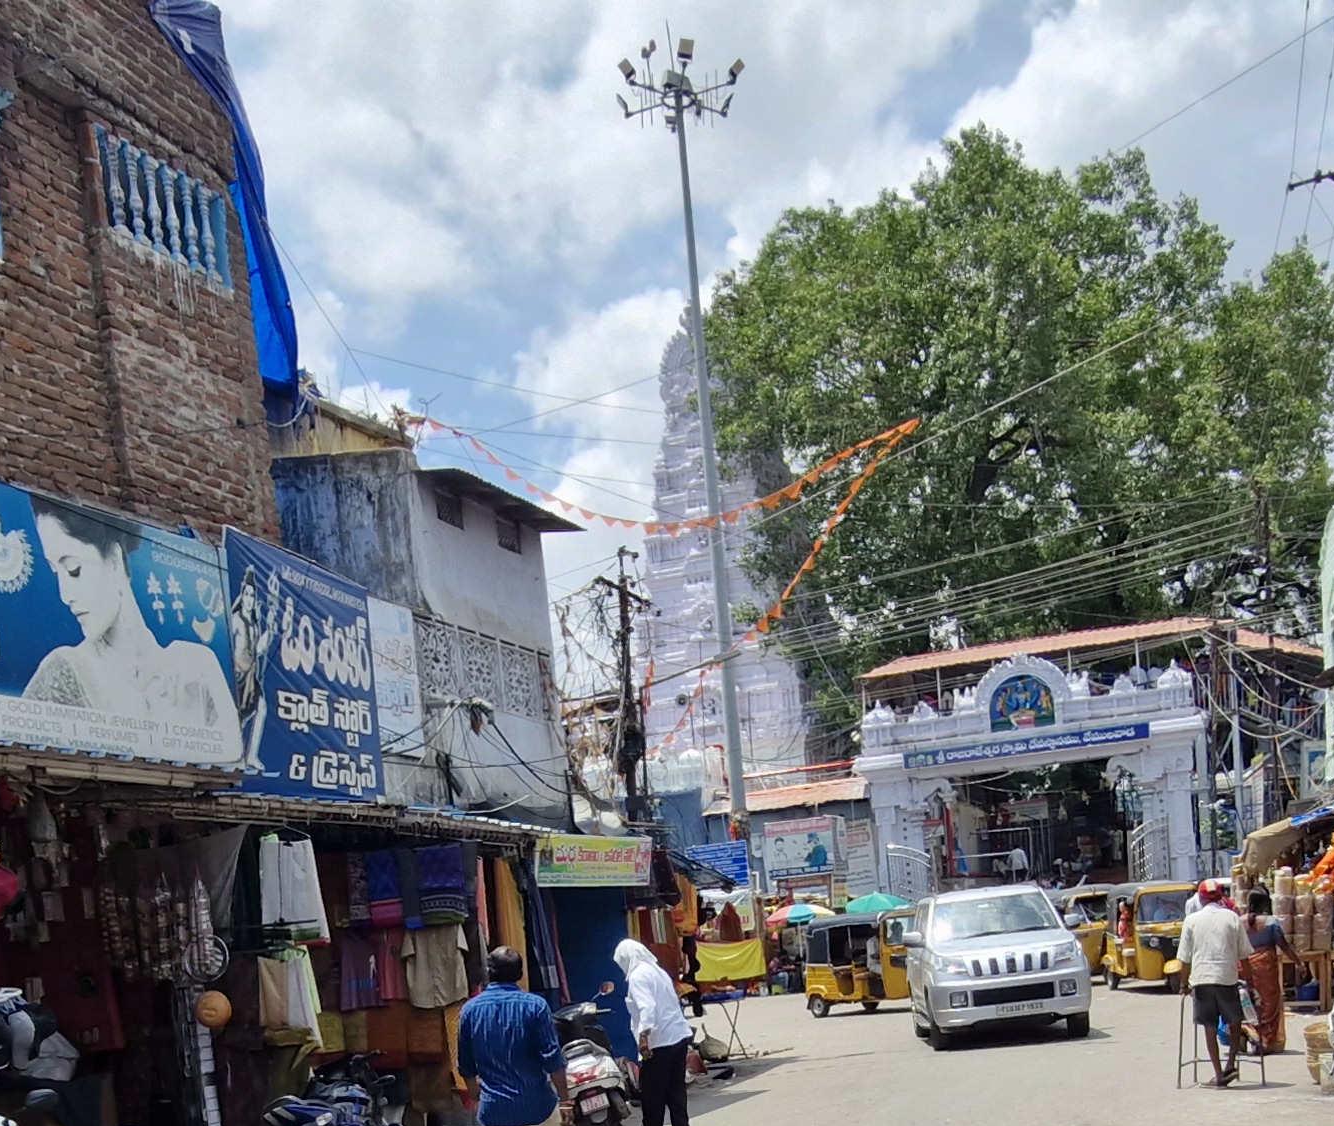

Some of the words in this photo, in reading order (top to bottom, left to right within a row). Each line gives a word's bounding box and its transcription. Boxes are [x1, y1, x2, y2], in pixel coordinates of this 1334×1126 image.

[280, 597, 316, 676] ఓం
[2, 714, 63, 734] PRODUCTS
[89, 727, 140, 744] PERFUMES
[162, 737, 183, 749] GIFT
[184, 740, 224, 756] ARTICLES
[8, 699, 43, 715] GOLD
[110, 715, 160, 732] JEWELLERY
[172, 725, 225, 742] COSMETICS
[277, 688, 329, 733] క్లాత్
[334, 698, 373, 748] స్టోర్
[289, 754, 308, 781] &
